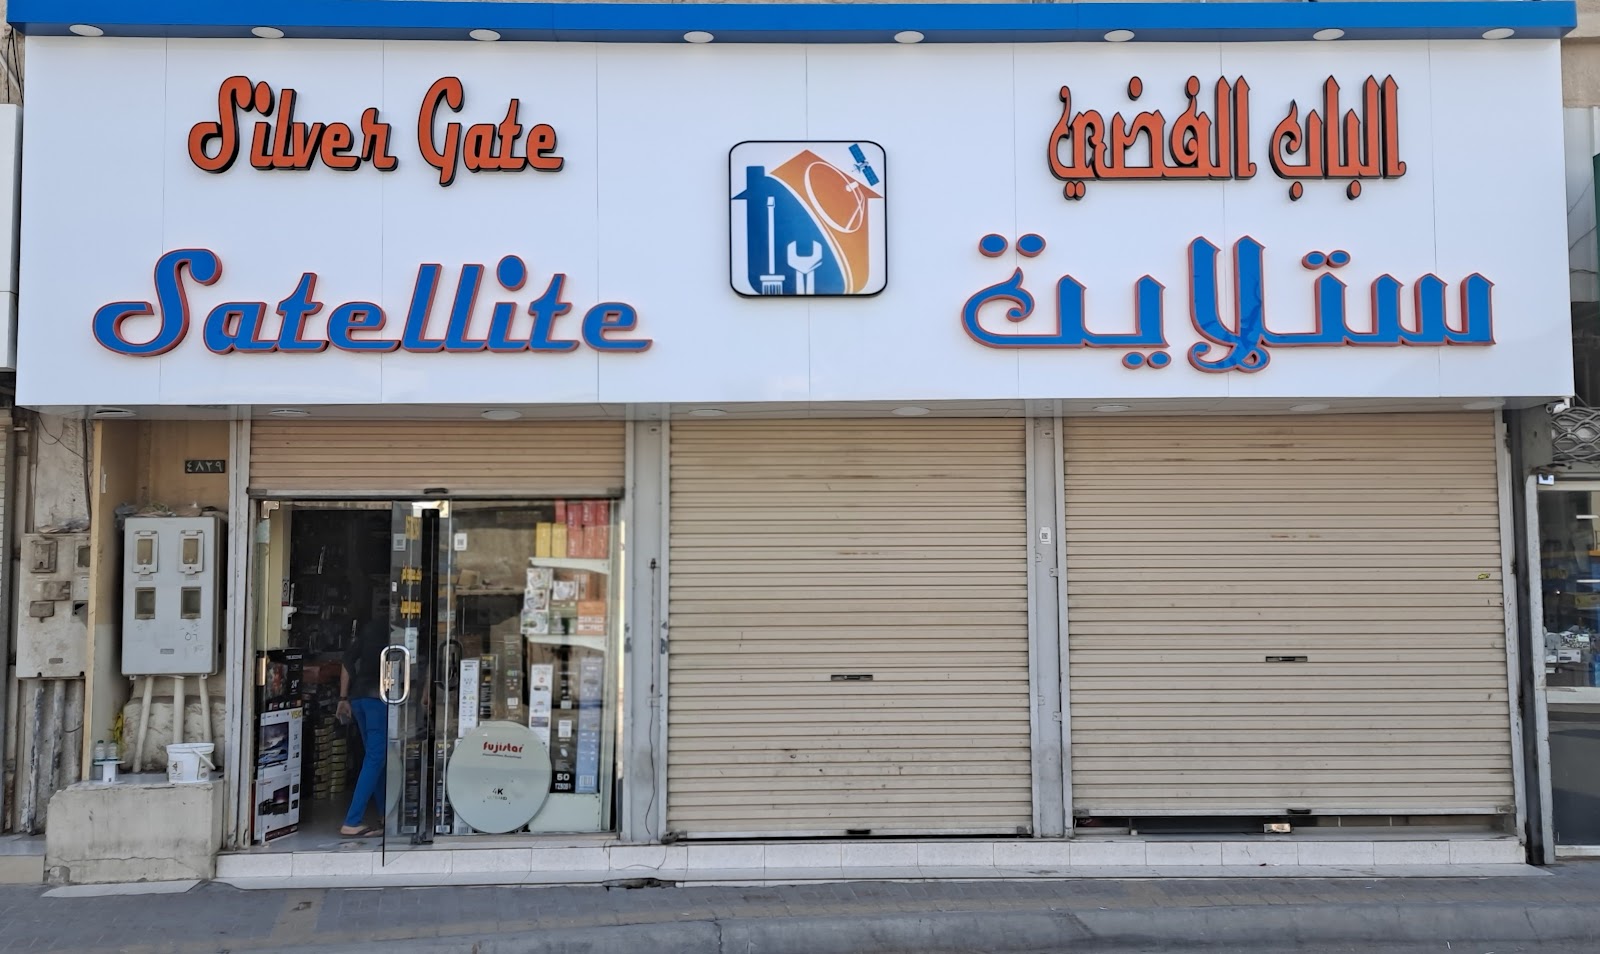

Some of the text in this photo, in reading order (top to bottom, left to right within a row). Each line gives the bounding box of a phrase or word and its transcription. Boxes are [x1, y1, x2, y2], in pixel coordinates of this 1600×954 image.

[188, 76, 564, 187] Silver Gate
[1047, 75, 1406, 201] الباب الفضي
[93, 249, 652, 357] Satellite
[962, 234, 1494, 373] ستلايت
[483, 741, 523, 754] fujistar
[492, 787, 504, 795] 4K
